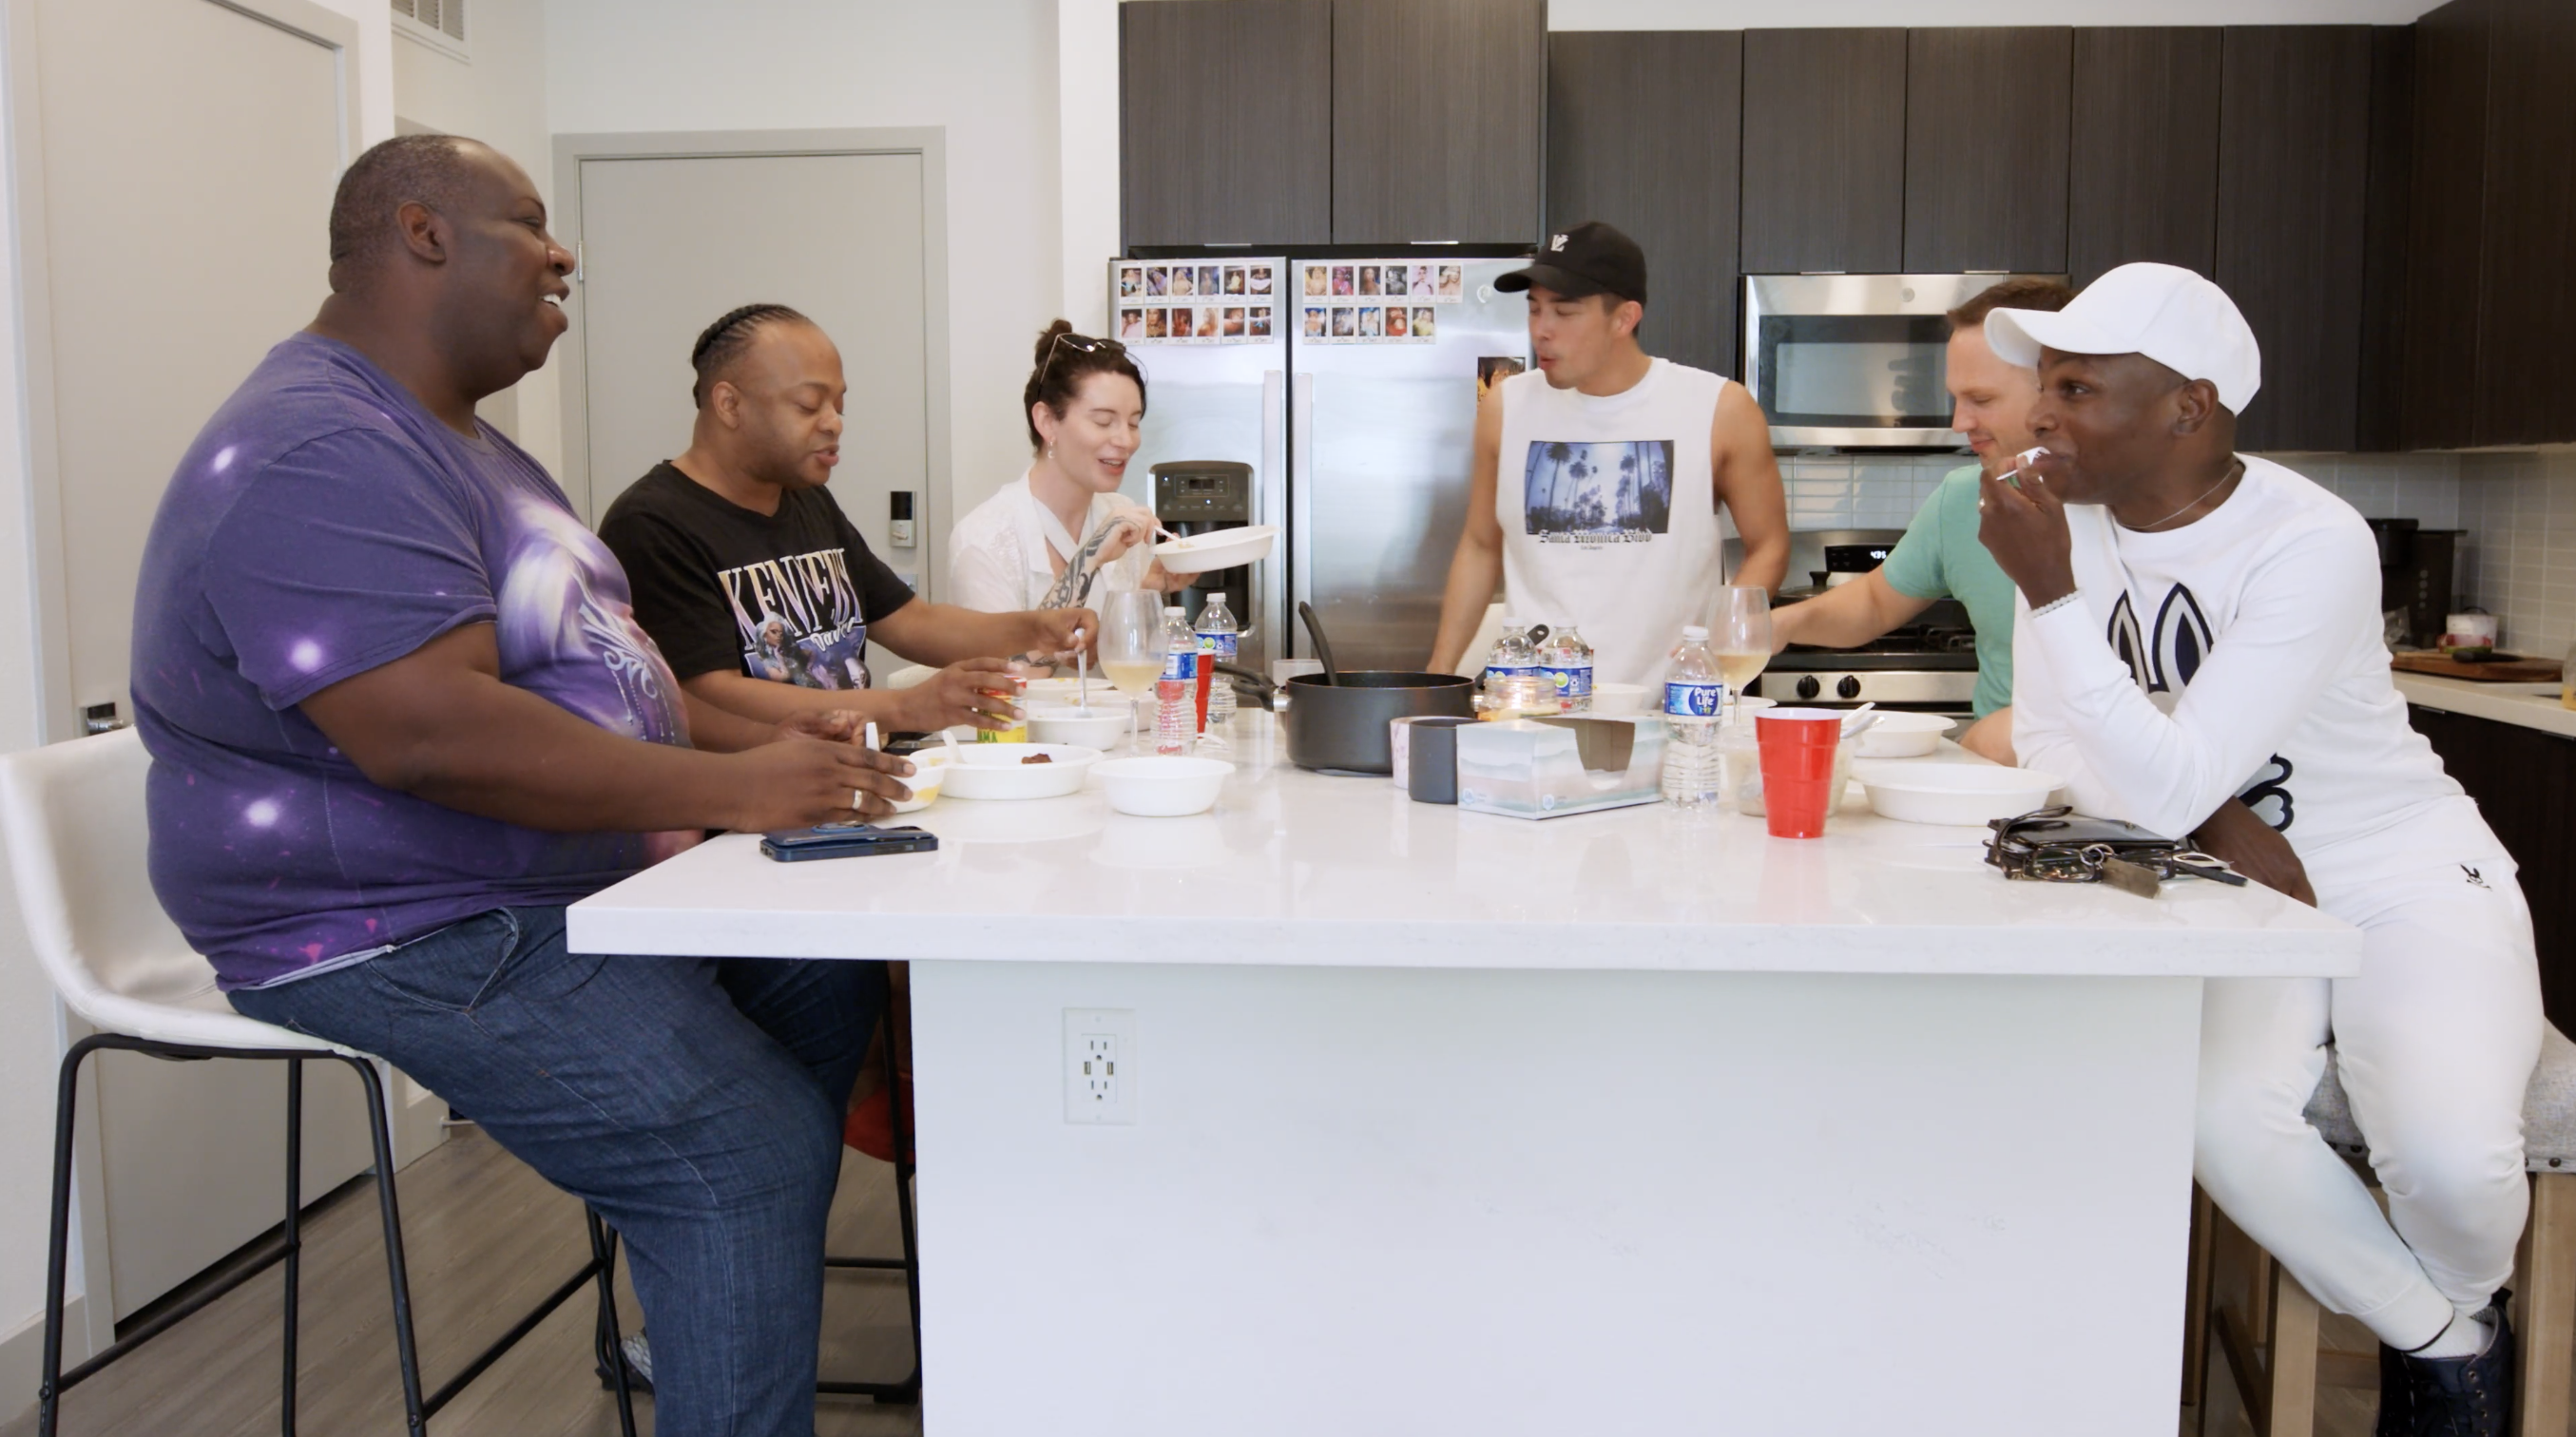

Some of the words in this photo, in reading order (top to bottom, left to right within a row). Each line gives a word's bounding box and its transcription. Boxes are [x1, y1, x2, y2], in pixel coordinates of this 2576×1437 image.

[1539, 528, 1570, 544] Santa
[1572, 528, 1620, 544] Monica
[1694, 686, 1717, 697] Pure
[1697, 696, 1715, 708] Life
